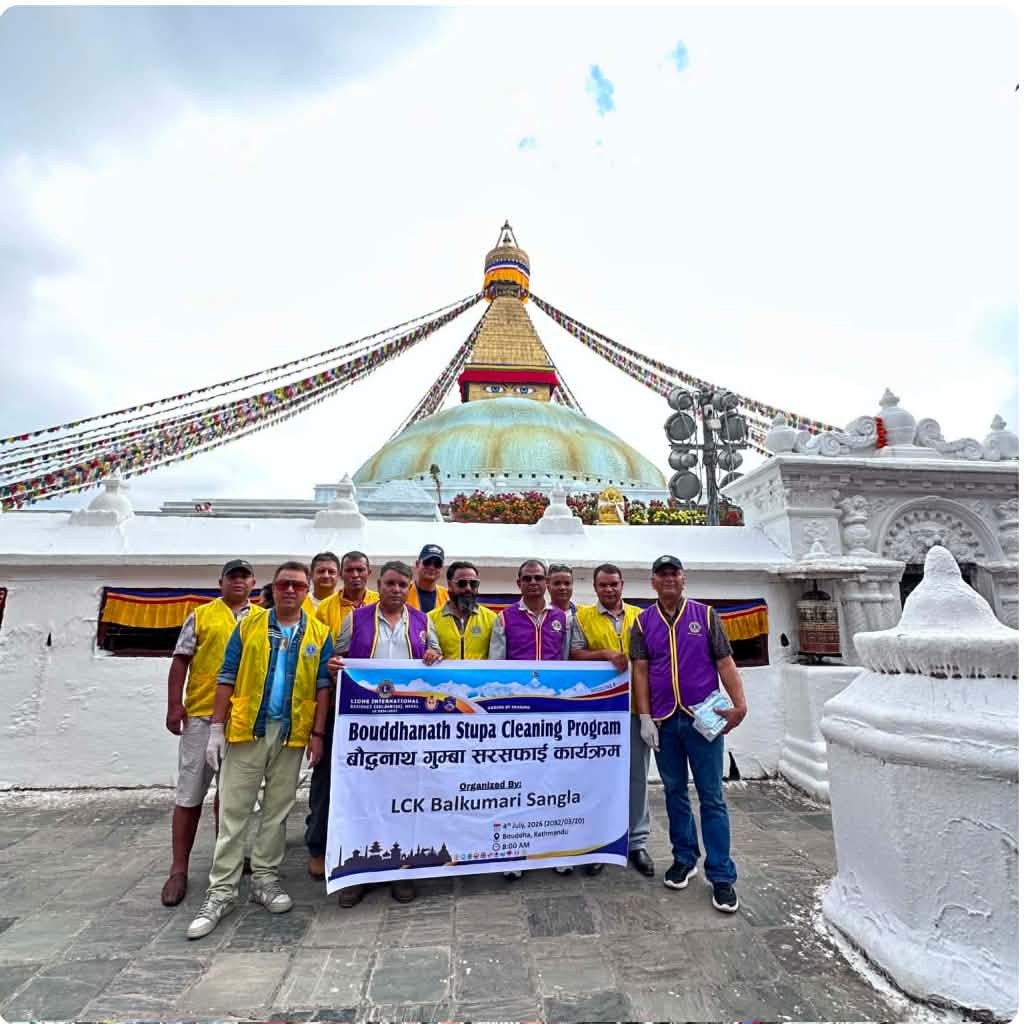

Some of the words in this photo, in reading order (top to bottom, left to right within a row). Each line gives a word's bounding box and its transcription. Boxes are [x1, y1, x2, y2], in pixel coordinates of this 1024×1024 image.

[348, 720, 451, 741] Bouddhanath
[456, 720, 496, 742] Stupa
[501, 719, 563, 741] Cleaning
[567, 719, 621, 739] Program
[423, 749, 466, 769] गुम्बा
[471, 743, 549, 764] सरसफाई
[553, 742, 622, 760] कार्यक्रम
[458, 781, 505, 792] Organized
[508, 780, 522, 790] By:
[391, 797, 425, 813] LCK
[431, 793, 521, 812] Balkumari
[526, 789, 581, 808] Sangla
